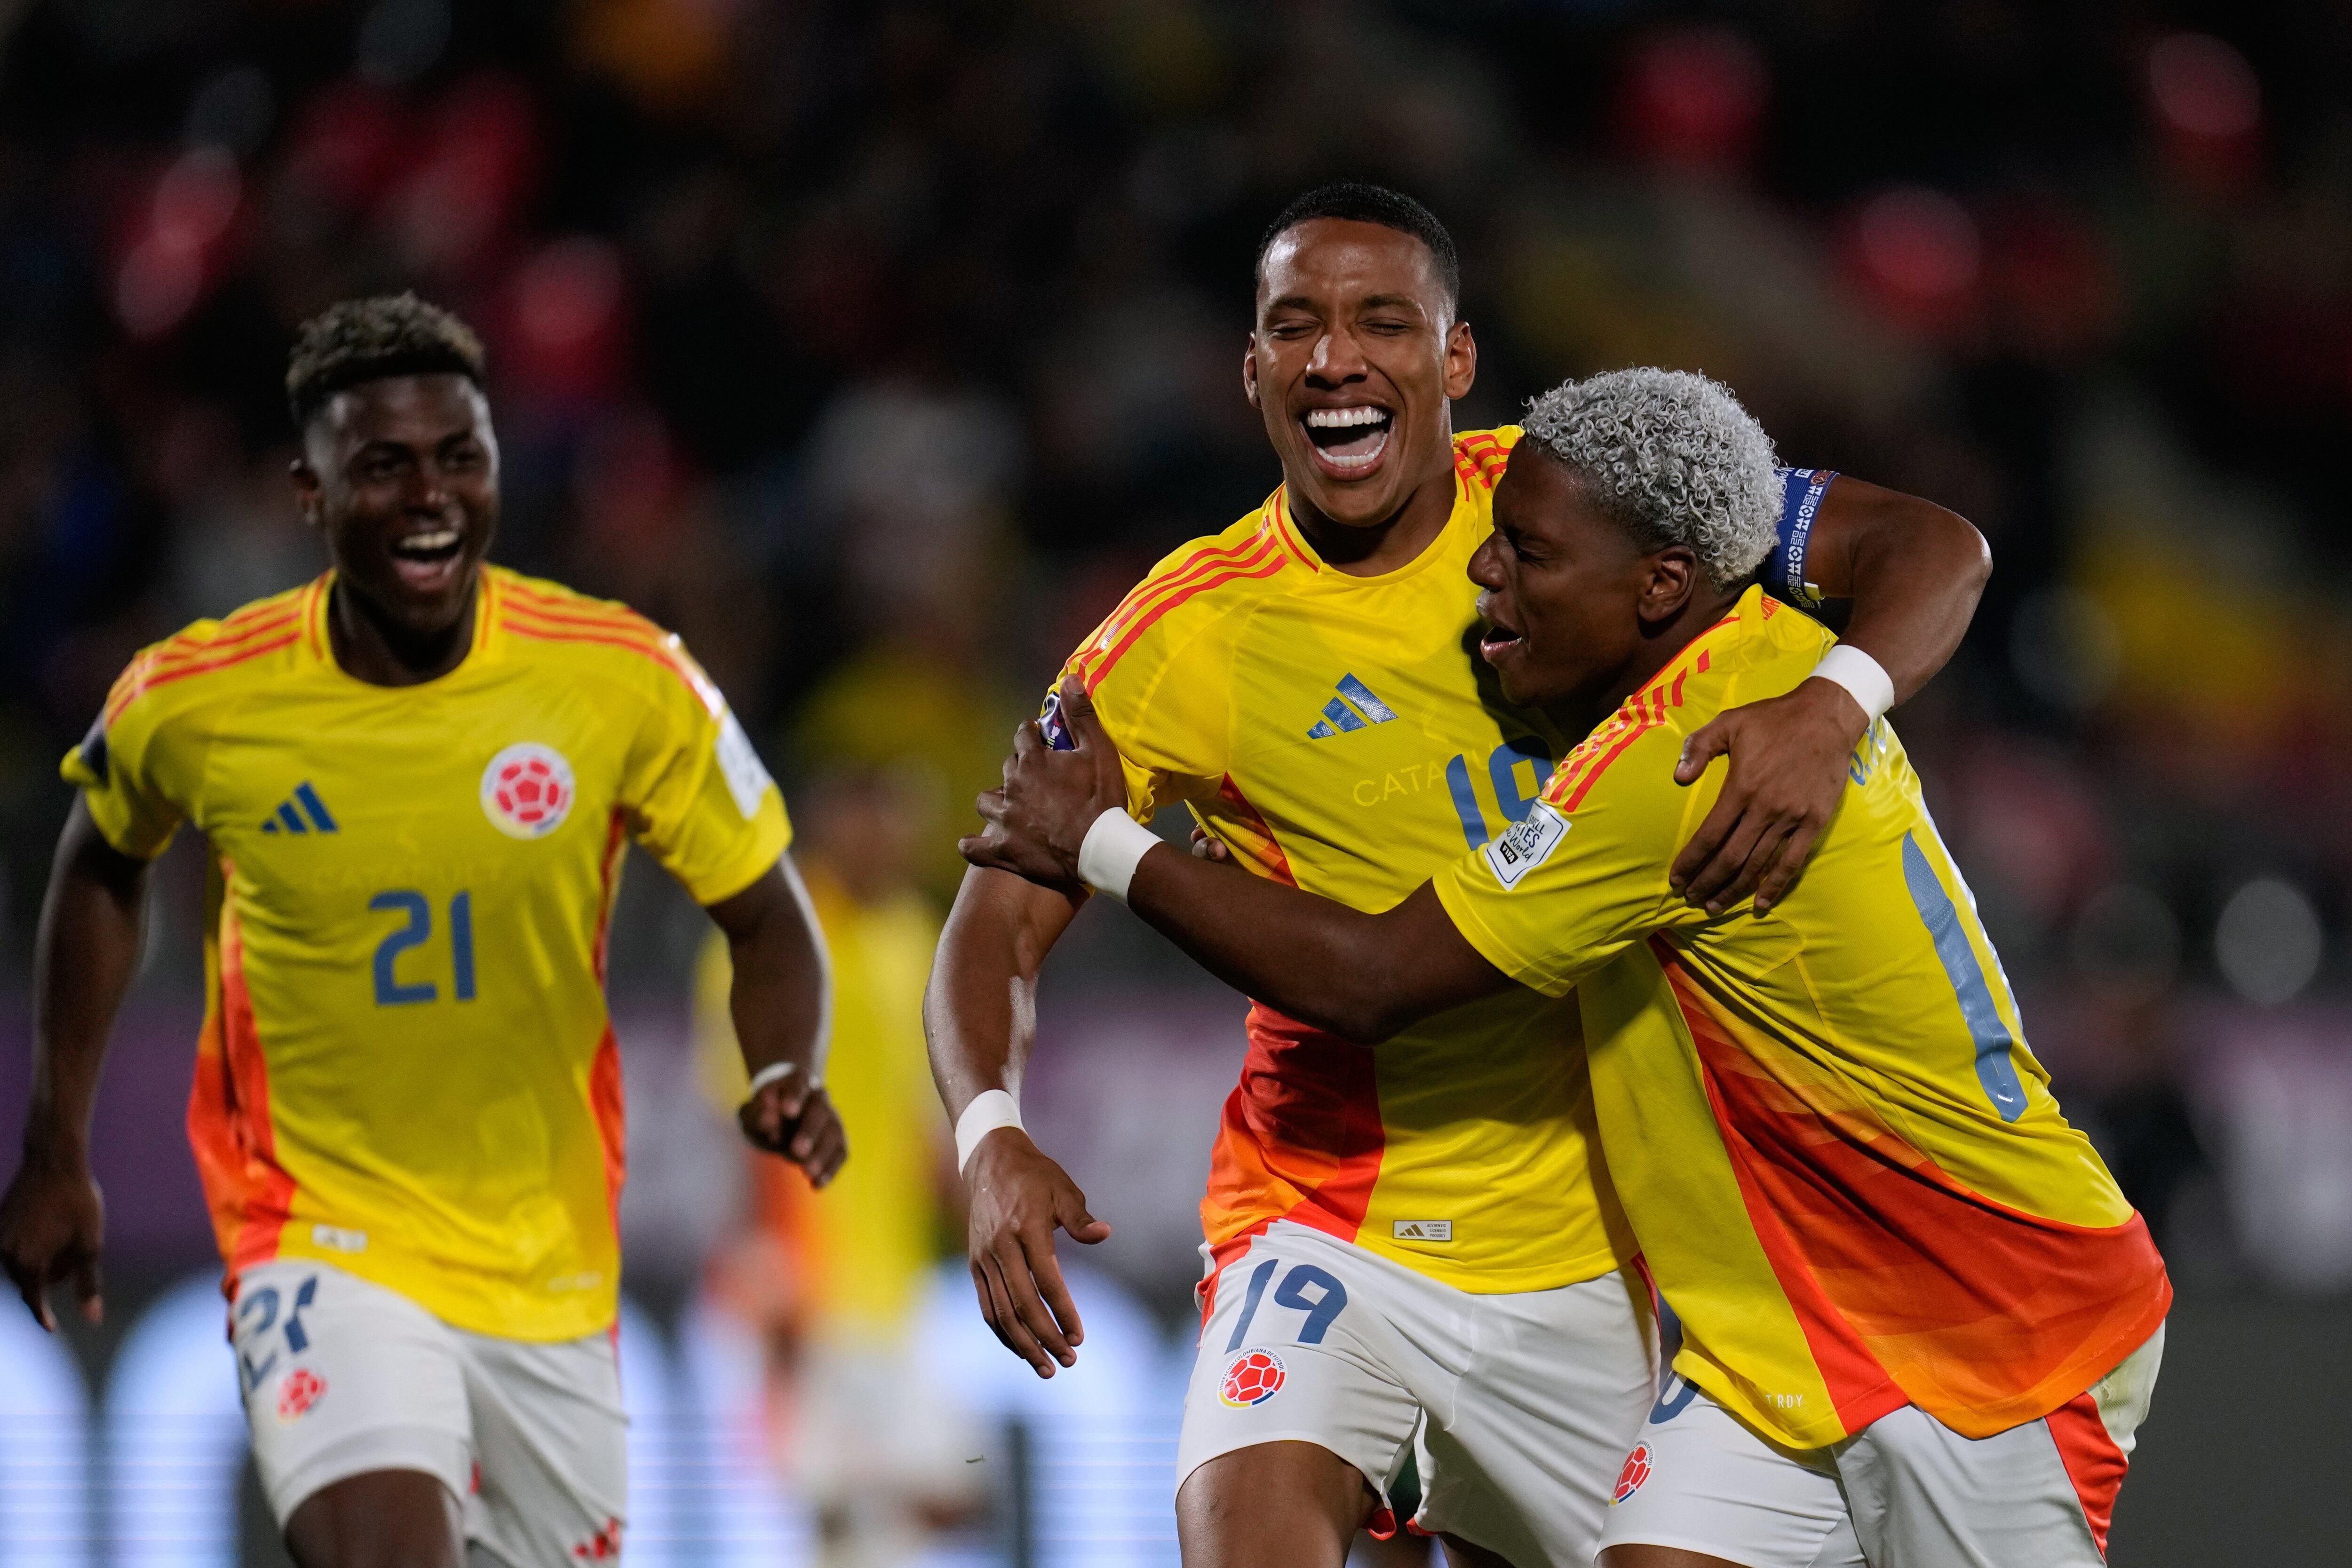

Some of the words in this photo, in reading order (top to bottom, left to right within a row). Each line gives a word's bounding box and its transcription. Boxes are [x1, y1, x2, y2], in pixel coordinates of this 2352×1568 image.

[1502, 844, 1515, 863] FIFA
[1510, 832, 1534, 863] World
[368, 888, 477, 1006] 21
[1224, 1259, 1348, 1355] 19
[1235, 1348, 1266, 1363] COLOMBIANA
[1272, 1355, 1285, 1370] FUTBOL
